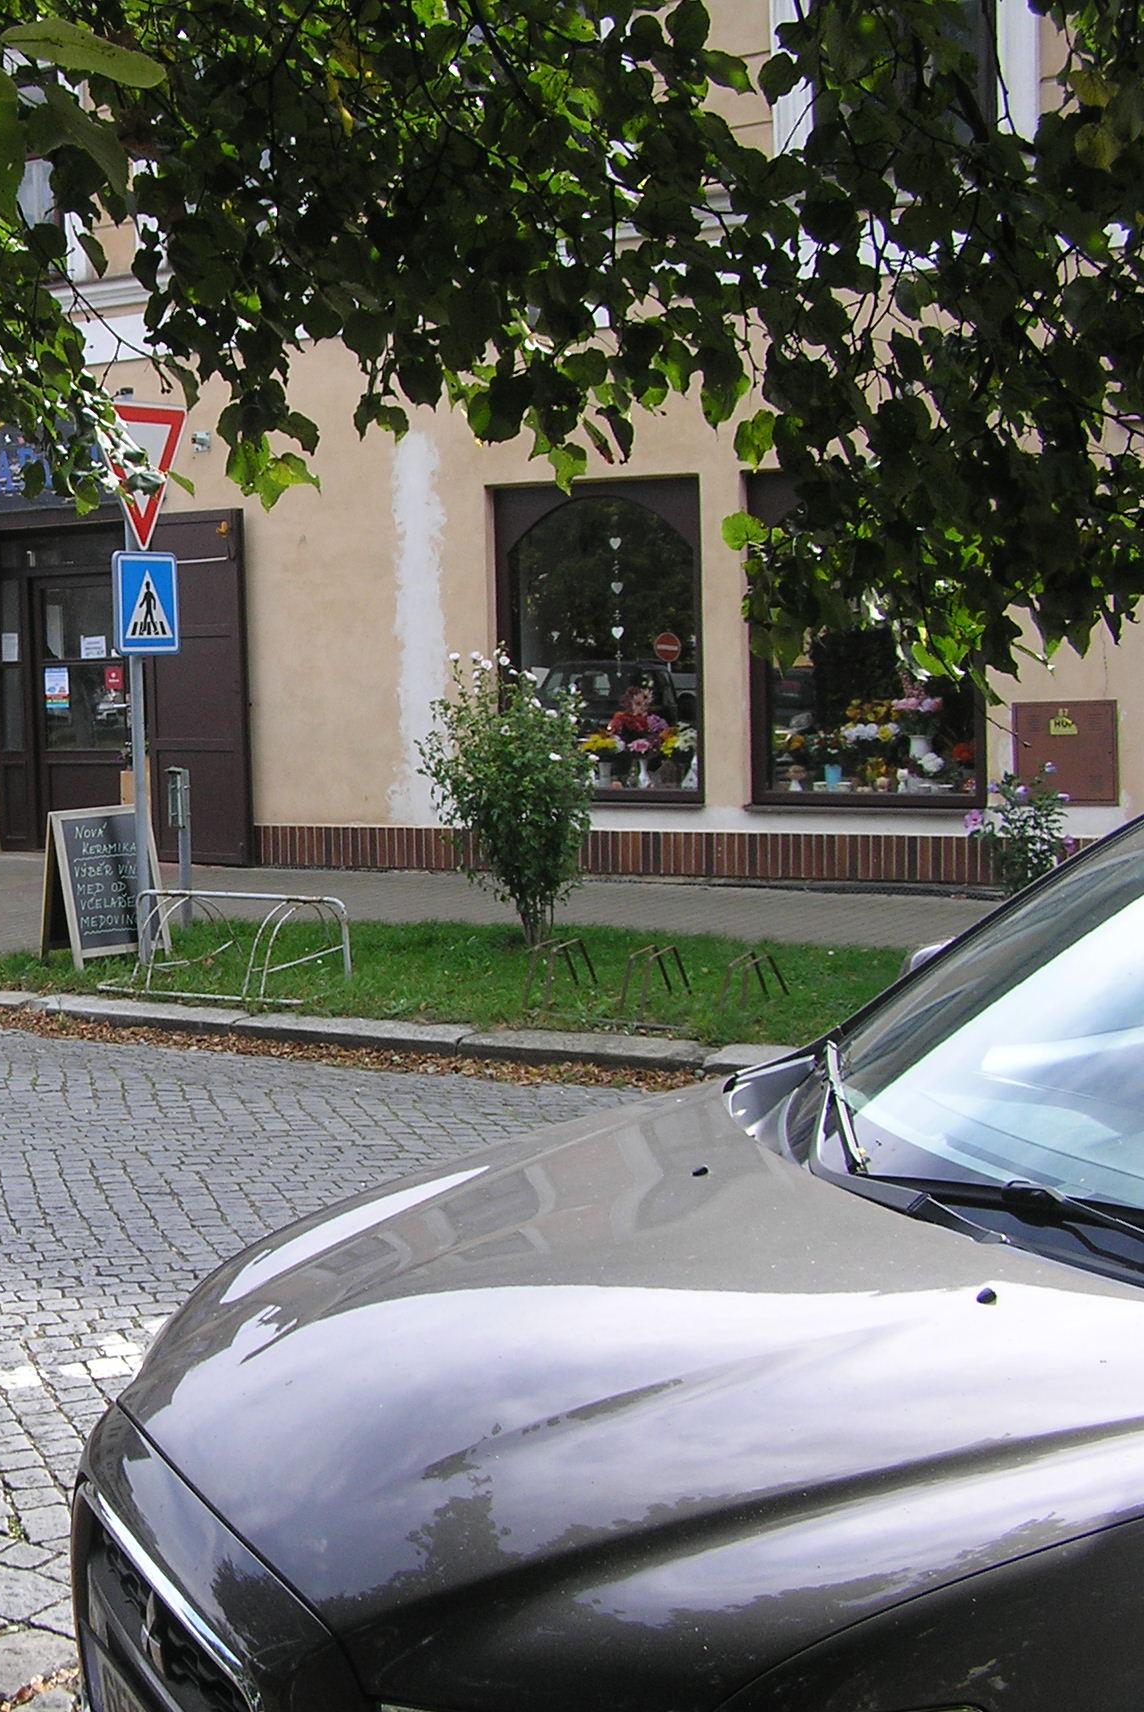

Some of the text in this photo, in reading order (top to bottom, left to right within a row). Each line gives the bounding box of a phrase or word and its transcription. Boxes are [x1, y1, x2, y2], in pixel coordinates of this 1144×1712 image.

[74, 821, 107, 839] NOVÁ
[82, 841, 137, 855] KERAMIKA
[74, 861, 113, 878] VÝBĚR
[76, 881, 126, 897] MED OD
[80, 914, 137, 929] MEDOVIN
